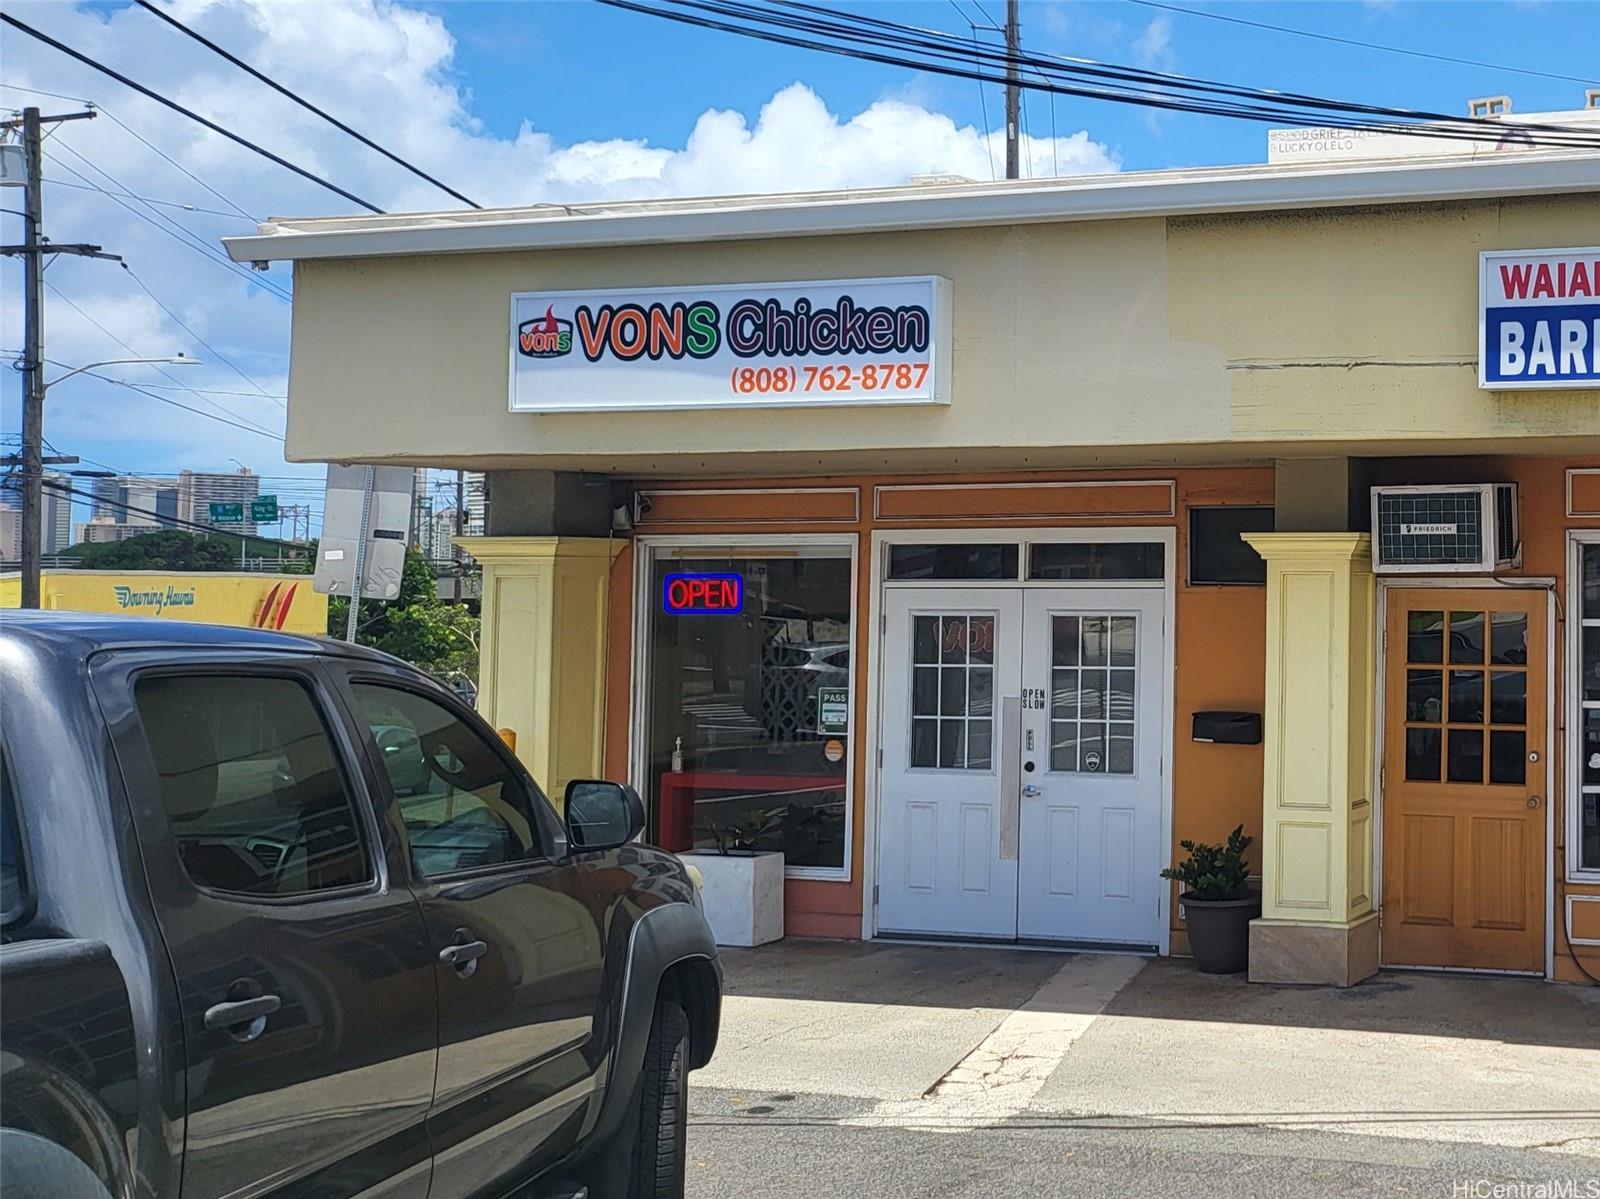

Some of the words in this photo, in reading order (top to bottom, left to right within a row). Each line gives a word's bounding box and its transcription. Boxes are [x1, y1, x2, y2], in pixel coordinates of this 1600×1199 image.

[1500, 261, 1600, 300] WAIA
[575, 301, 721, 362] VONS
[726, 295, 930, 358] Chicken
[1500, 319, 1600, 376] BAR
[731, 367, 796, 394] (808)
[803, 363, 929, 392] 762-8787
[113, 586, 163, 616] Downing
[163, 585, 196, 607] Hawaii
[668, 579, 738, 609] OPEN
[824, 694, 846, 702] PASS
[1022, 688, 1045, 699] OPEN
[1022, 699, 1045, 709] SLOW
